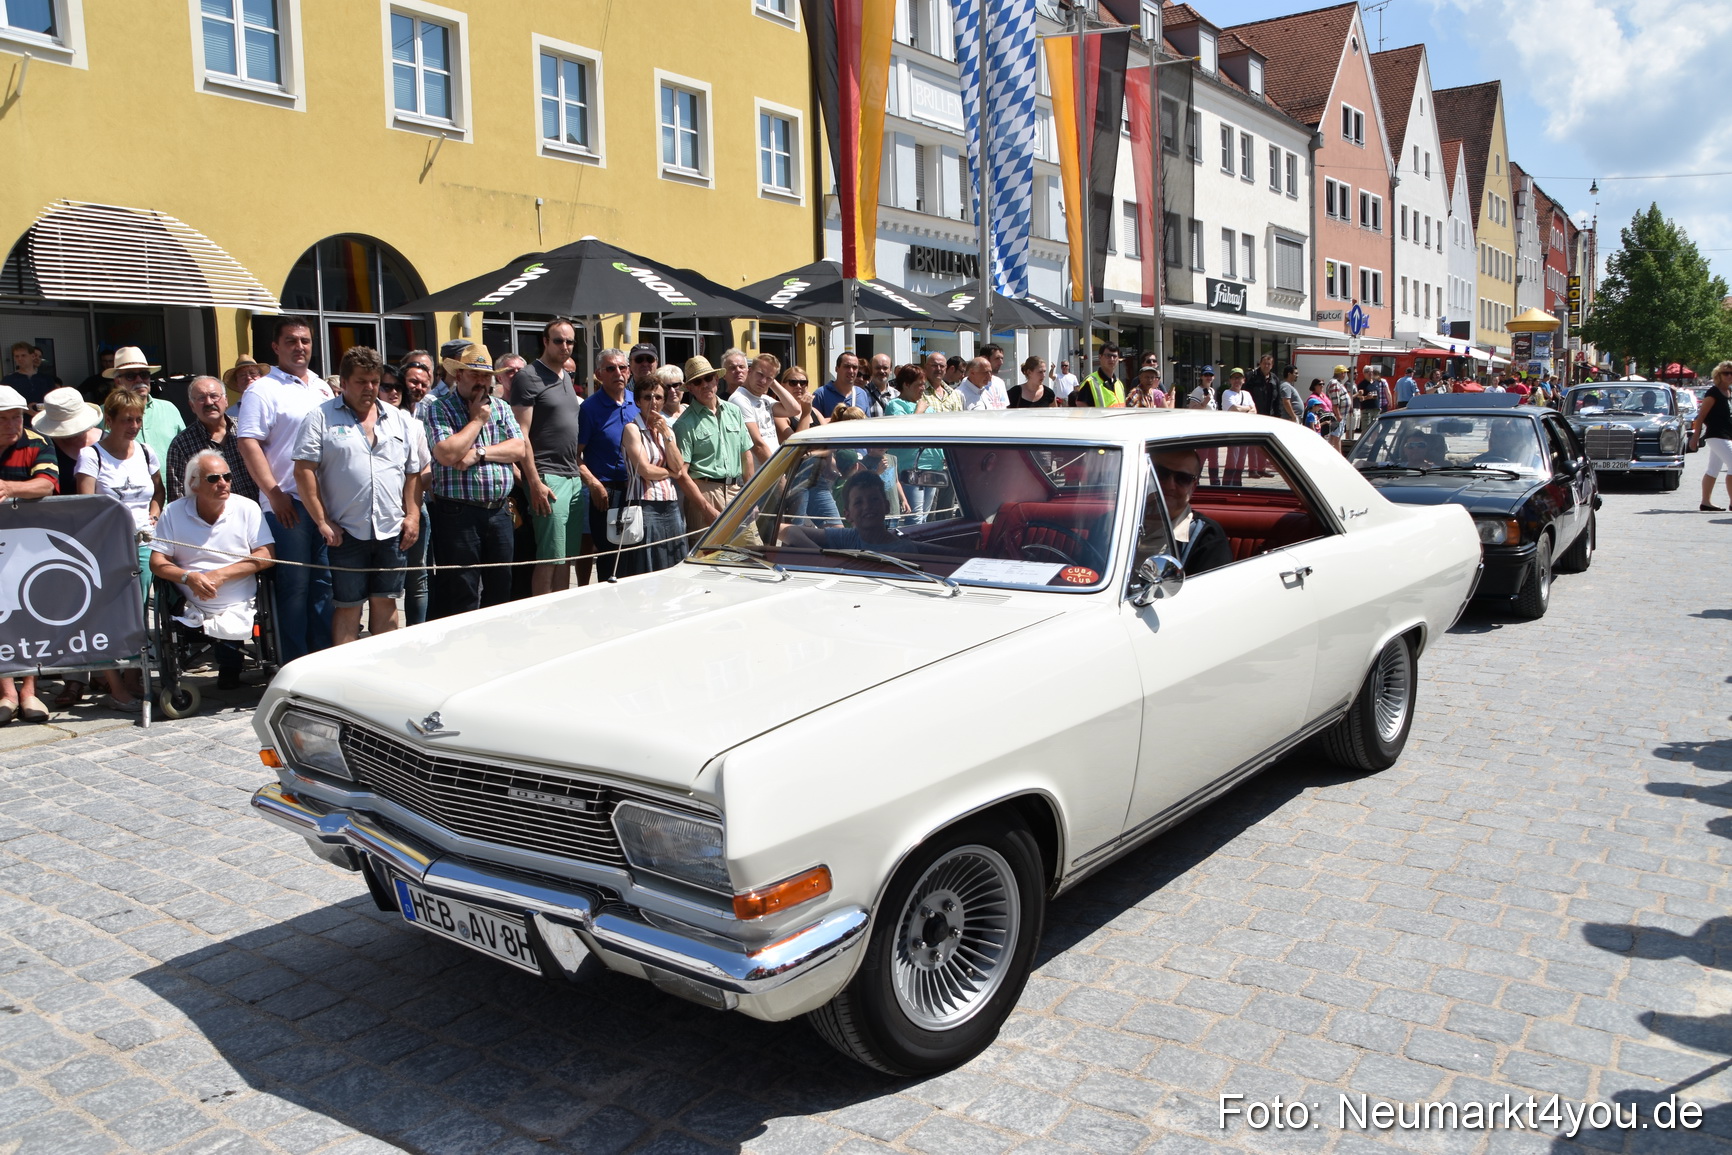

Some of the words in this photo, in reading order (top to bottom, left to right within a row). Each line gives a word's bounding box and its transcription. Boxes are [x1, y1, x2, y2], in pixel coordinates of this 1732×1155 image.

[1568, 276, 1580, 324] HOTE
[807, 335, 816, 346] 24
[1602, 461, 1611, 469] DB
[1067, 568, 1092, 576] CUBA
[1066, 576, 1091, 584] CLUB
[409, 889, 456, 932] HEB
[468, 911, 498, 949] AV
[501, 924, 537, 965] 8H
